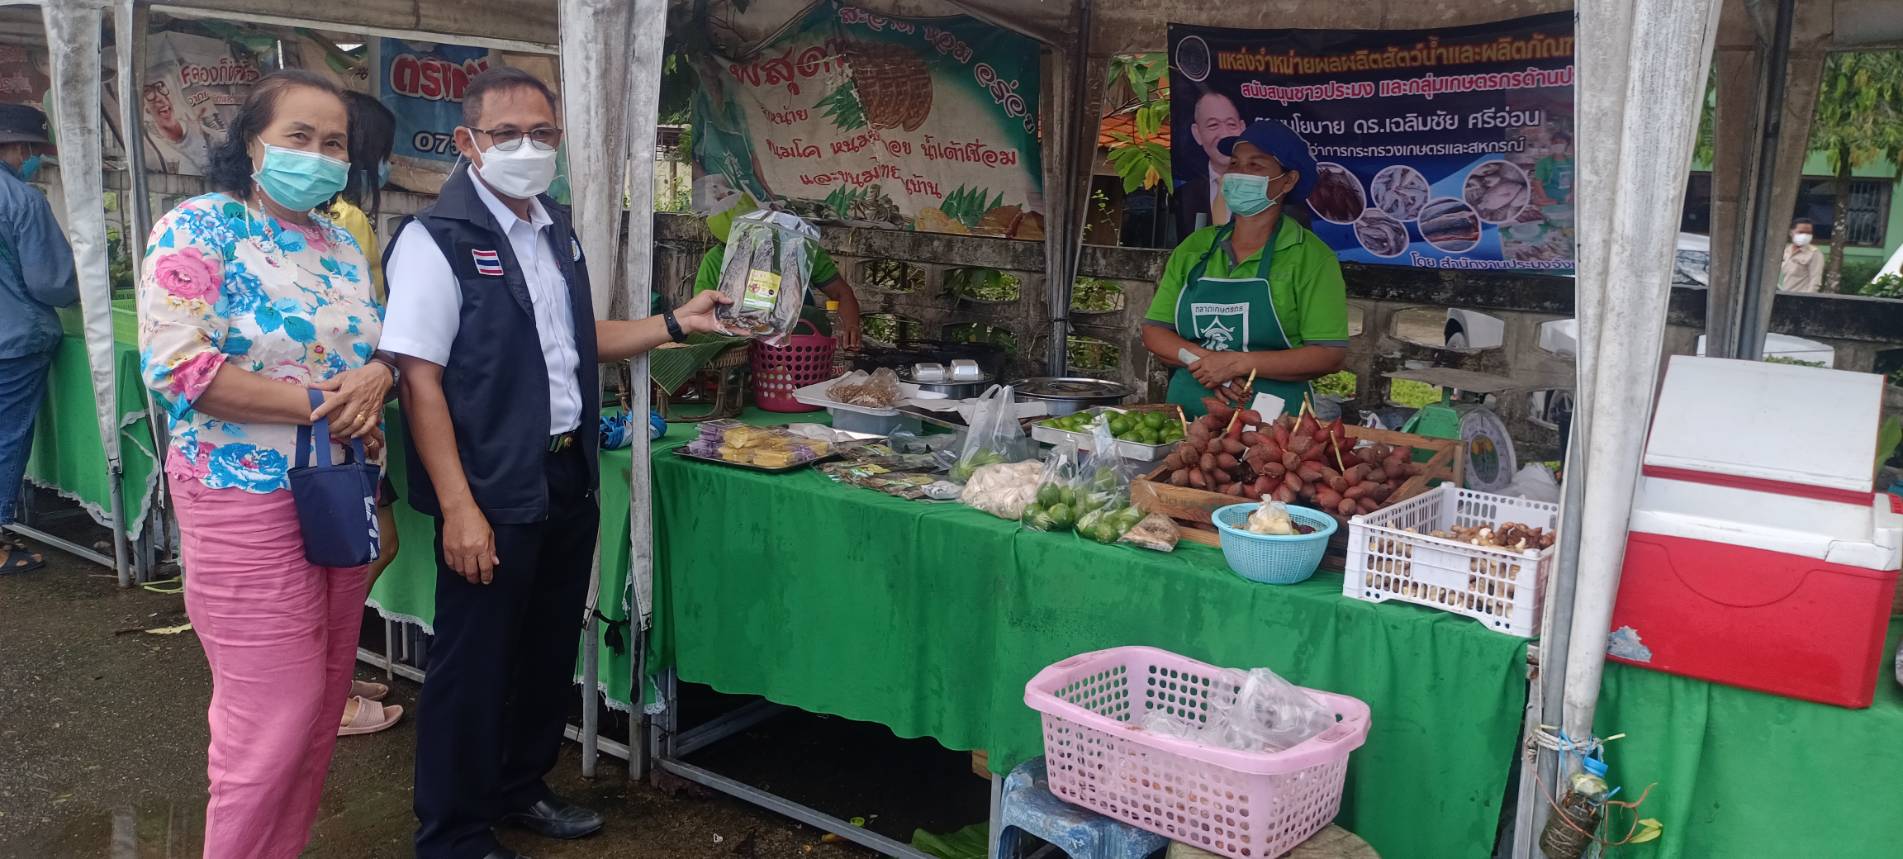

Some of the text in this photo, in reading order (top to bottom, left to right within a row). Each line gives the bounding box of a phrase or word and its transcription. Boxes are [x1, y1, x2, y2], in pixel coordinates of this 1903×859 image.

[1241, 66, 1574, 106] สนับสนุนชาวประมง และกลุ่มเกษตรกรด้านป
[1353, 110, 1458, 134] ดร.เฉลิมชัย
[1468, 105, 1540, 129] ศรีอ่อน
[1309, 136, 1525, 156] ว่าการกระทรวงเกษตรและสหกรณ์
[1410, 251, 1574, 270] โดย สำนักงานประมงจัง
